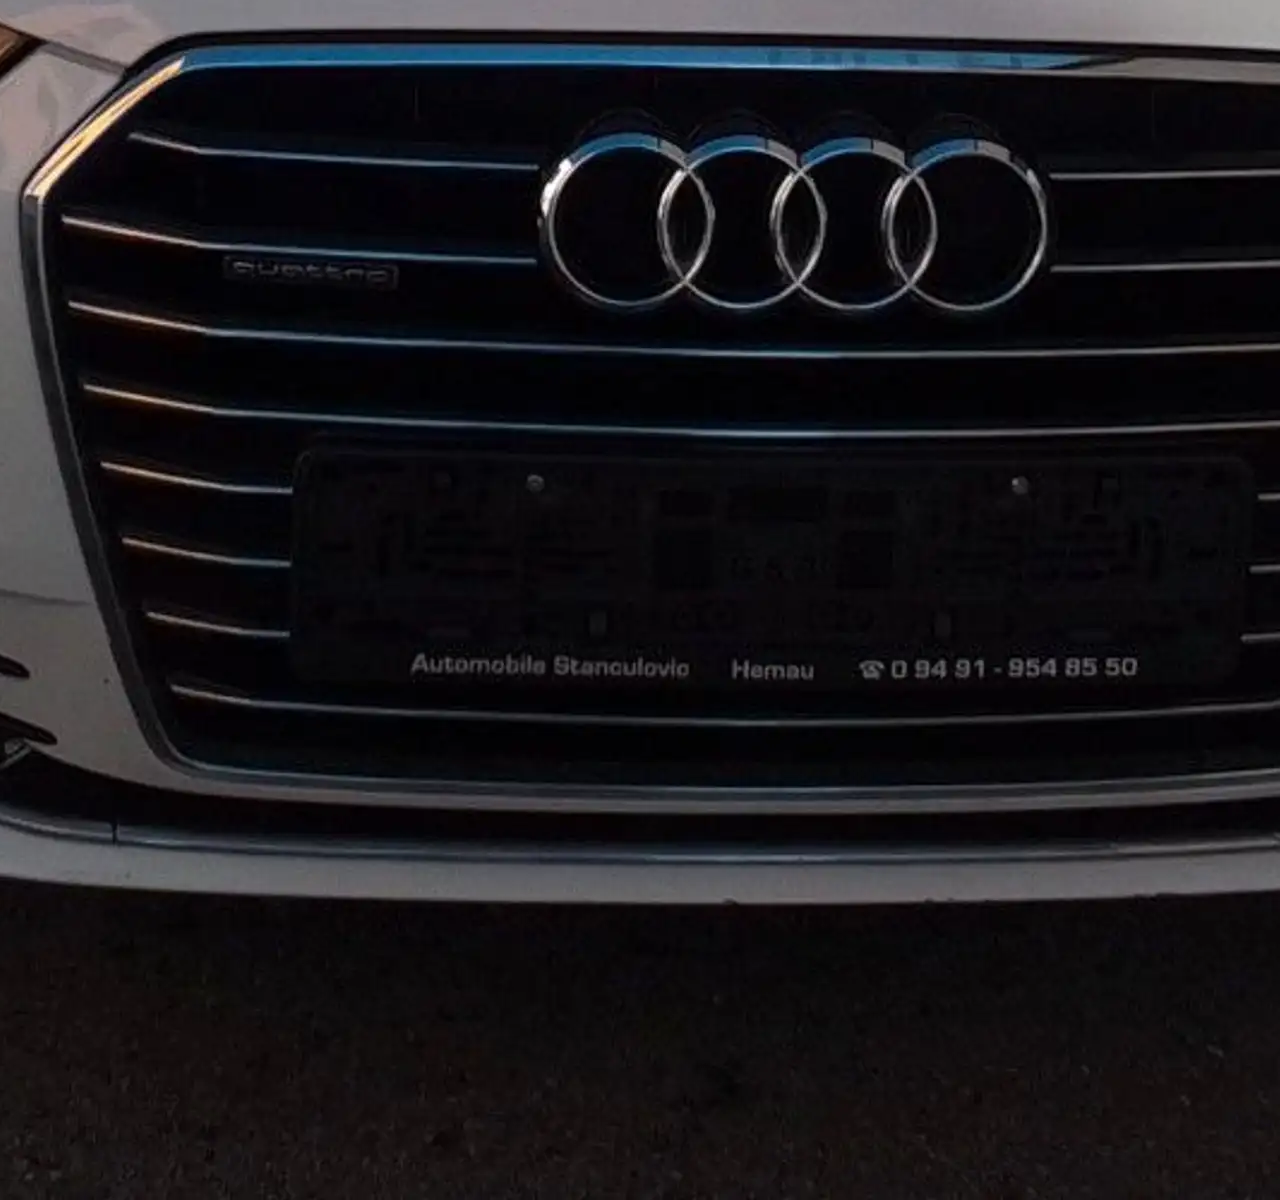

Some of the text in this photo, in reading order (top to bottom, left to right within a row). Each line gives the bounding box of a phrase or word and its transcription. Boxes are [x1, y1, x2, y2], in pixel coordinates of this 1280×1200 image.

[232, 260, 389, 284] quattro
[411, 653, 546, 675] Automobile
[731, 659, 814, 680] Hemau
[891, 659, 908, 680] 0
[914, 659, 947, 679] 94
[954, 658, 985, 679] 91
[1008, 657, 1057, 678] 954
[1064, 657, 1098, 677] 85
[1104, 657, 1138, 677] 50
